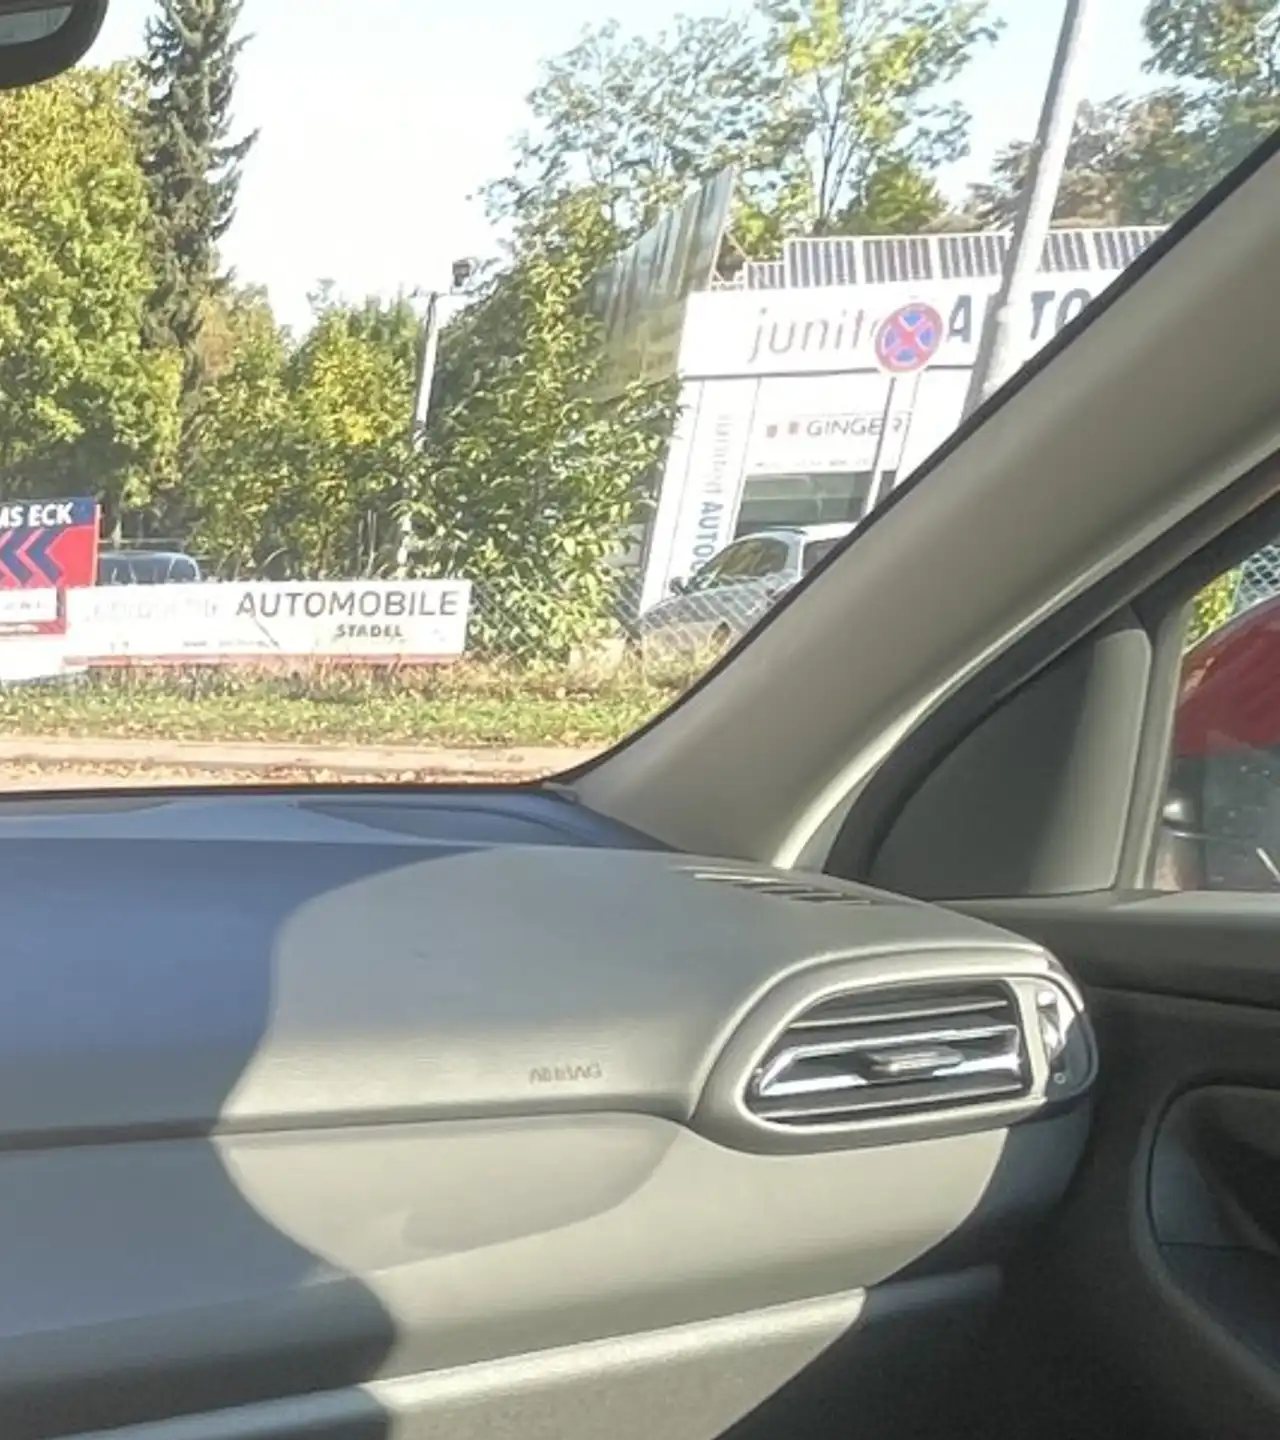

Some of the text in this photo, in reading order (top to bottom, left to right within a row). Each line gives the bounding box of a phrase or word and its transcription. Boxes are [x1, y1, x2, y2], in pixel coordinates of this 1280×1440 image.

[28, 501, 74, 527] ECK
[236, 590, 459, 618] AUTOMOBILE
[334, 623, 403, 639] STADEL
